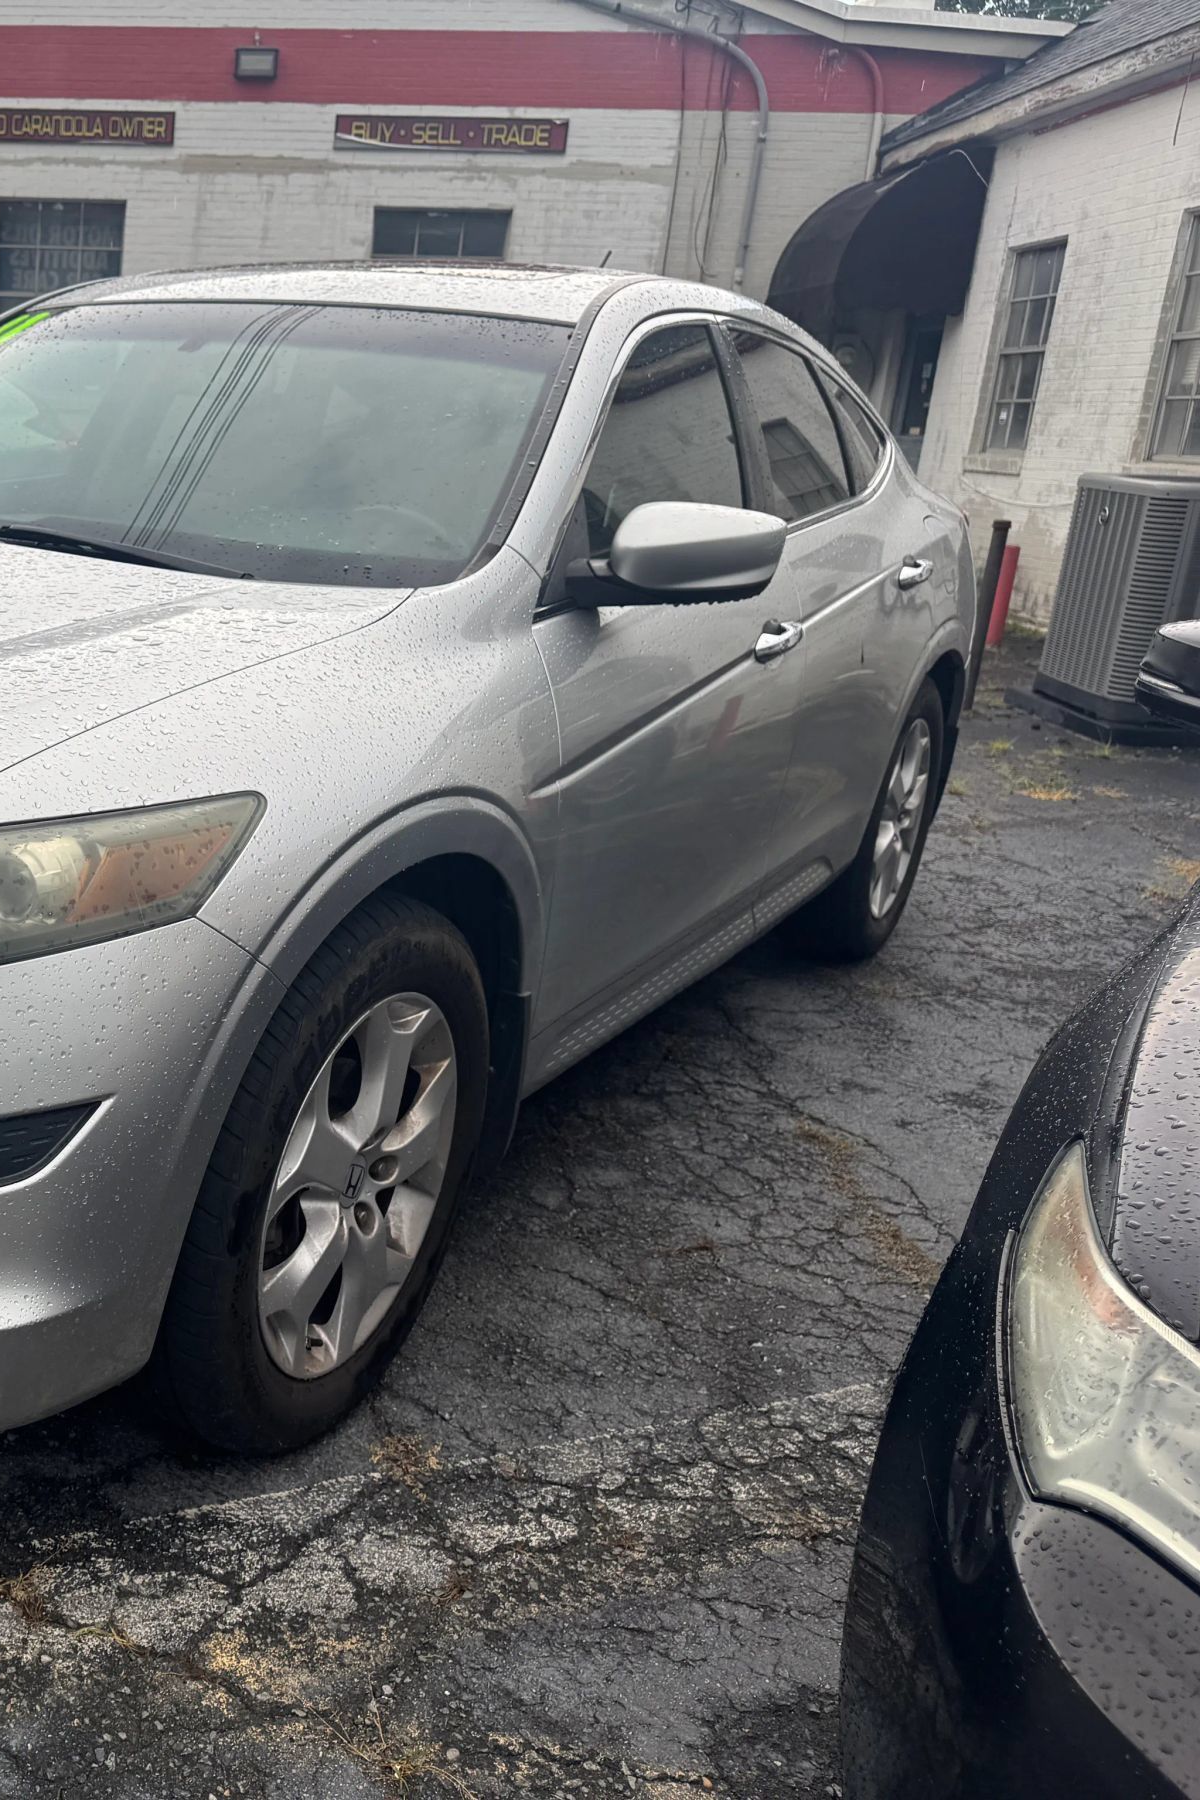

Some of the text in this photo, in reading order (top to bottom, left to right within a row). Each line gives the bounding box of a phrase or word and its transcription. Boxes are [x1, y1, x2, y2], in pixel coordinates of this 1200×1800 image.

[108, 116, 167, 139] OWNER
[351, 121, 551, 146] BUY SELL TRADE
